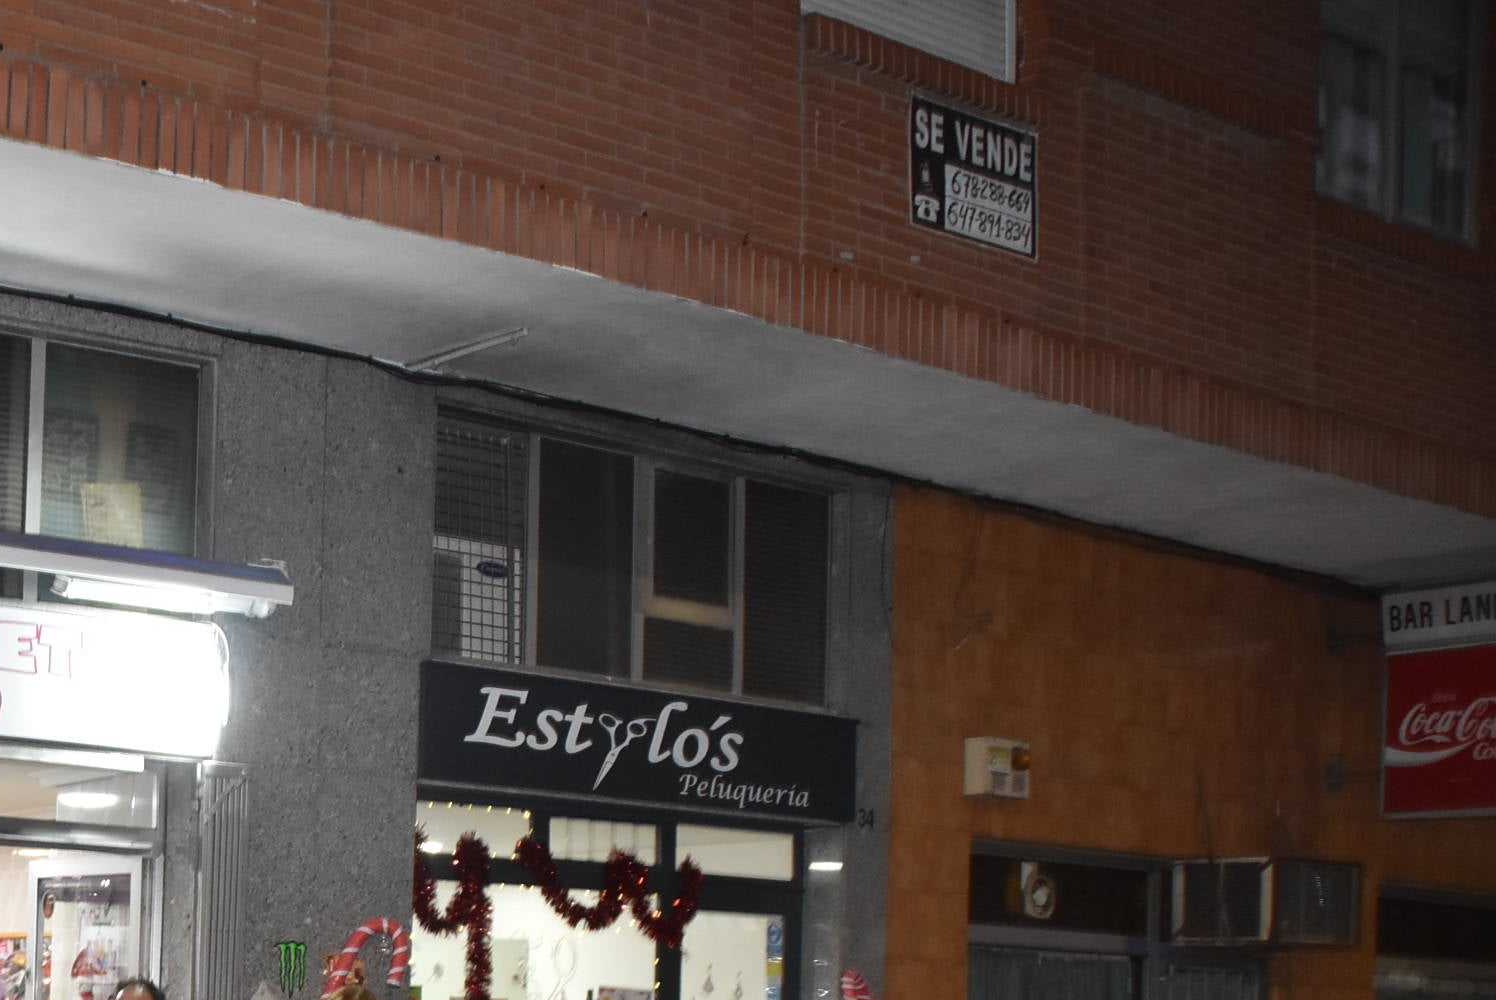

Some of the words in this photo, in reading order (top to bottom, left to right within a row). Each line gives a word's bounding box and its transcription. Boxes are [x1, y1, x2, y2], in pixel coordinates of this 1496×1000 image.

[915, 108, 944, 154] SE
[955, 120, 1032, 183] VENDE
[1389, 601, 1434, 633] BAR
[1445, 593, 1496, 626] LAN
[679, 773, 811, 811] Peluquería
